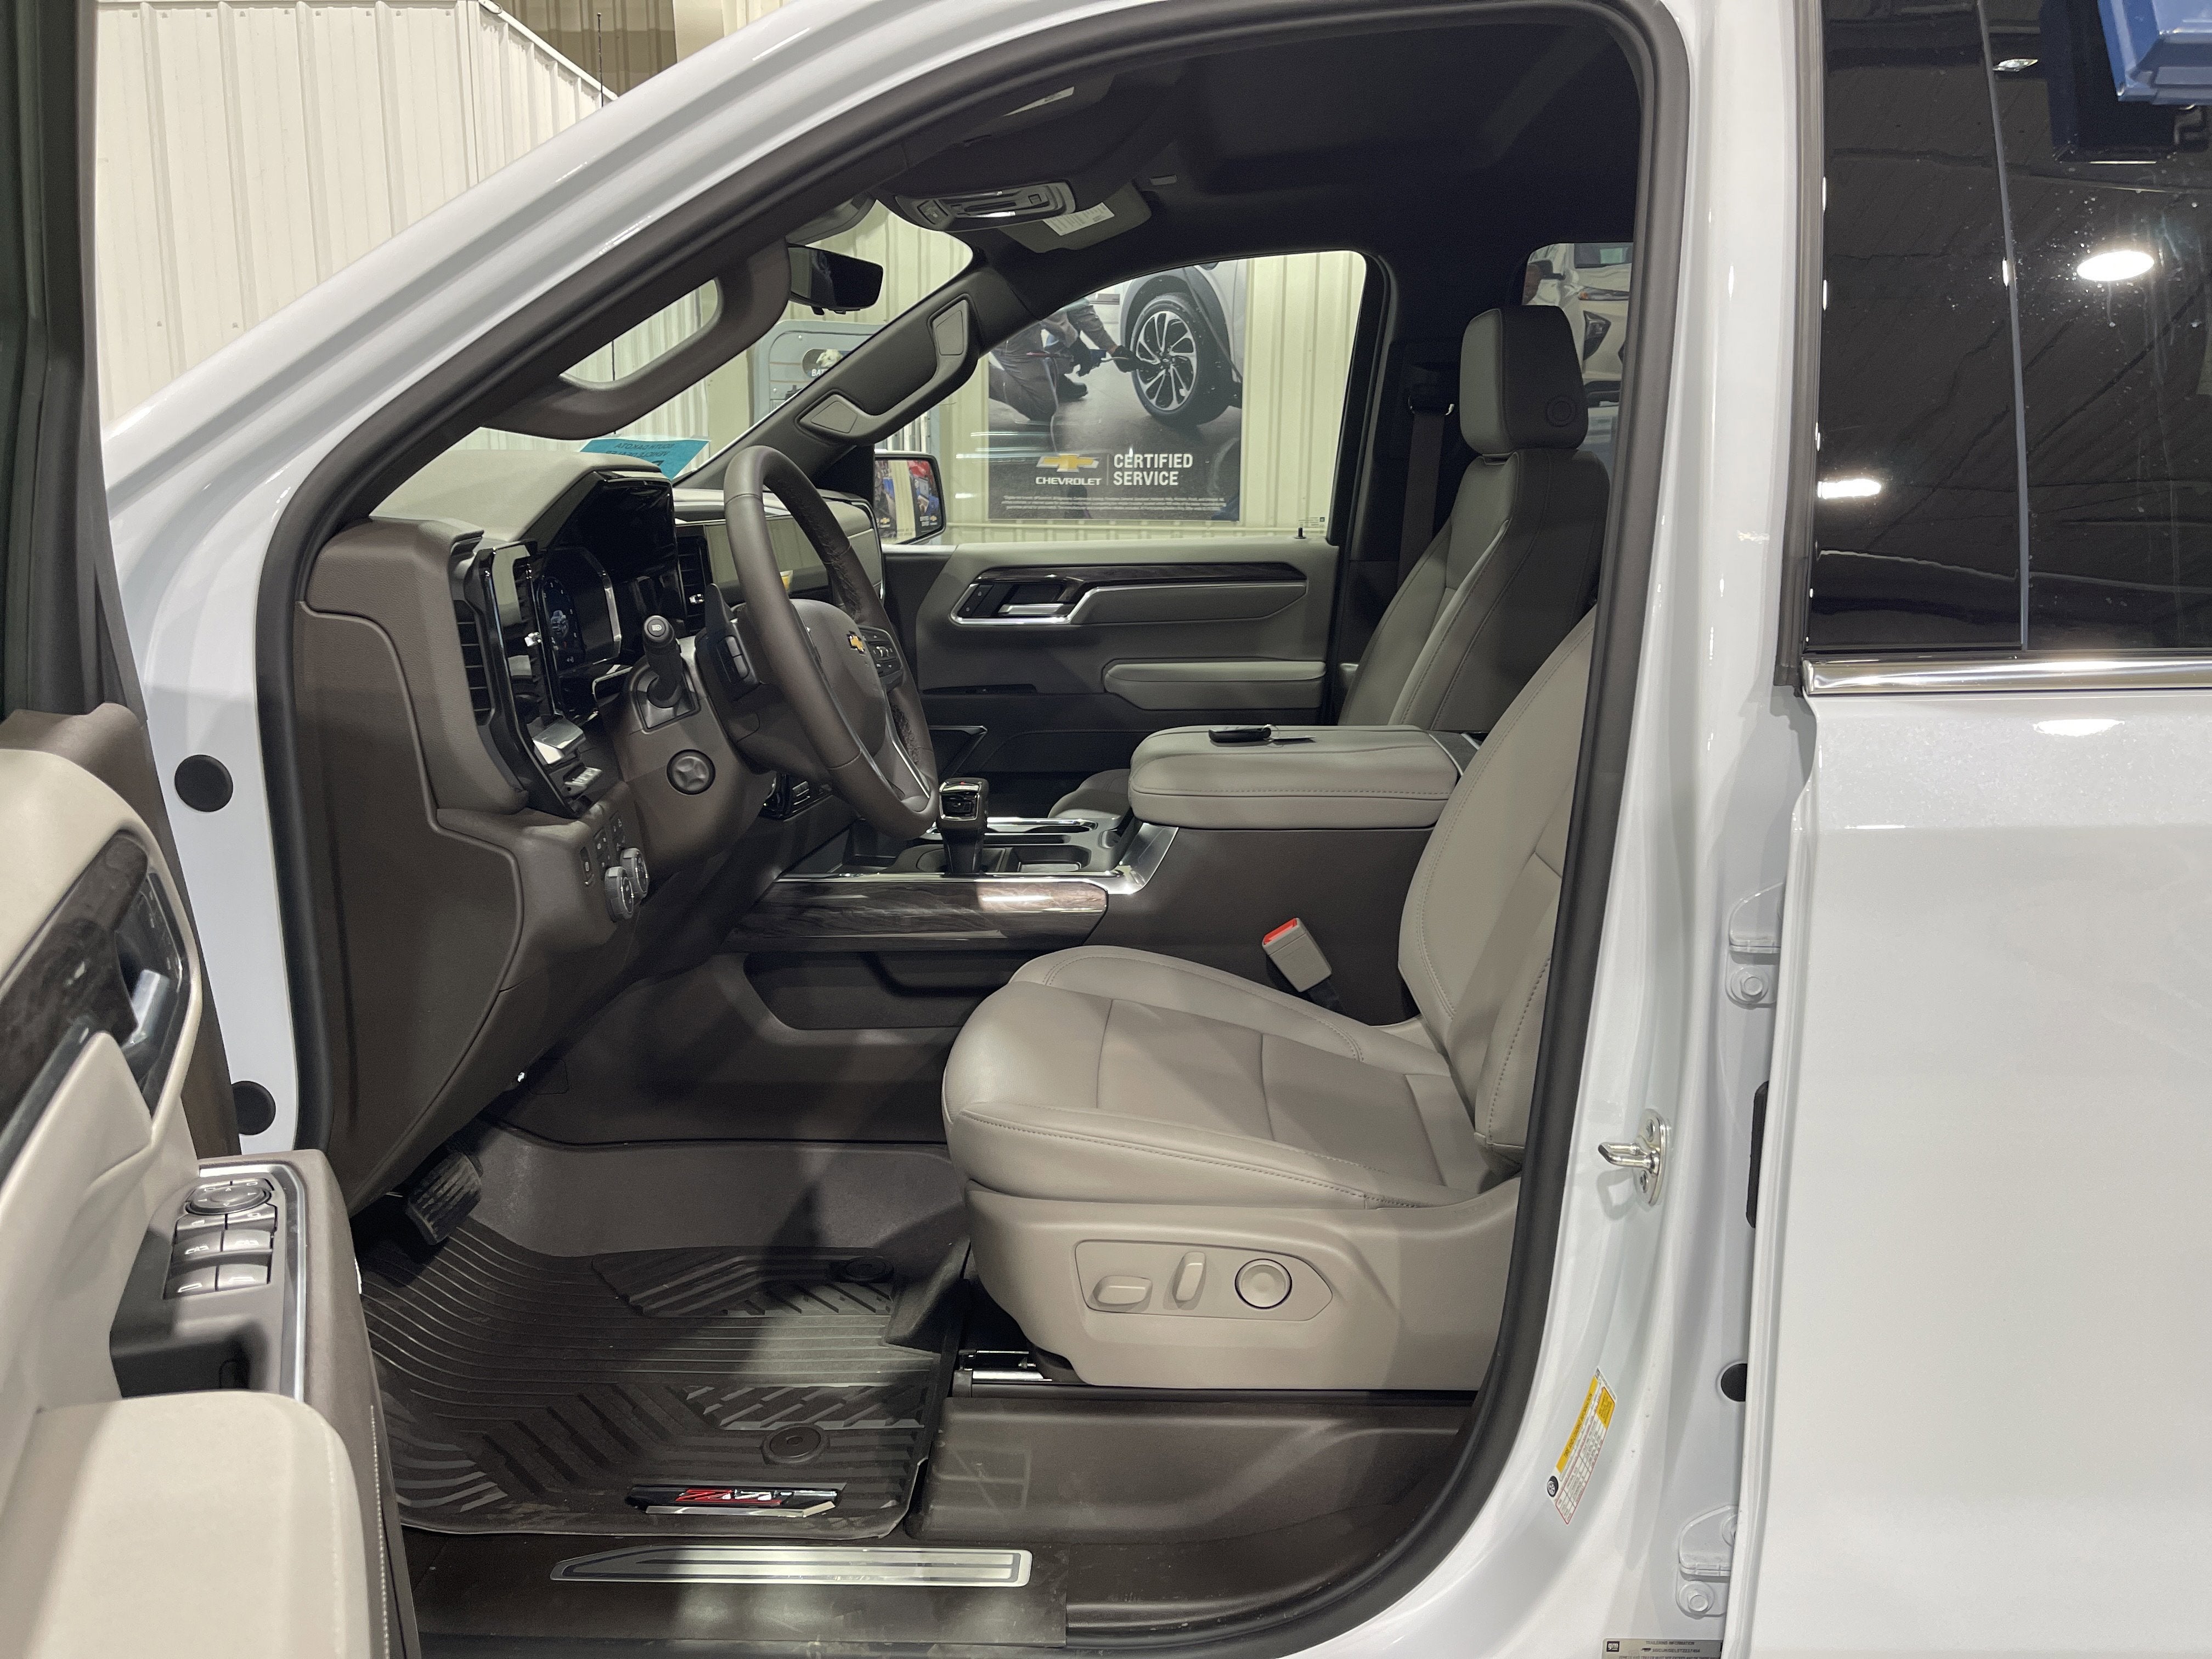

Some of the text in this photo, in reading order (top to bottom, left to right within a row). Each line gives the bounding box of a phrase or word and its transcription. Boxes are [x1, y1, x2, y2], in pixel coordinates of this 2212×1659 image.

[1114, 453, 1193, 469] CERTIFIED
[1035, 477, 1102, 486] CHEVROLET
[1113, 471, 1179, 486] SERVICE
